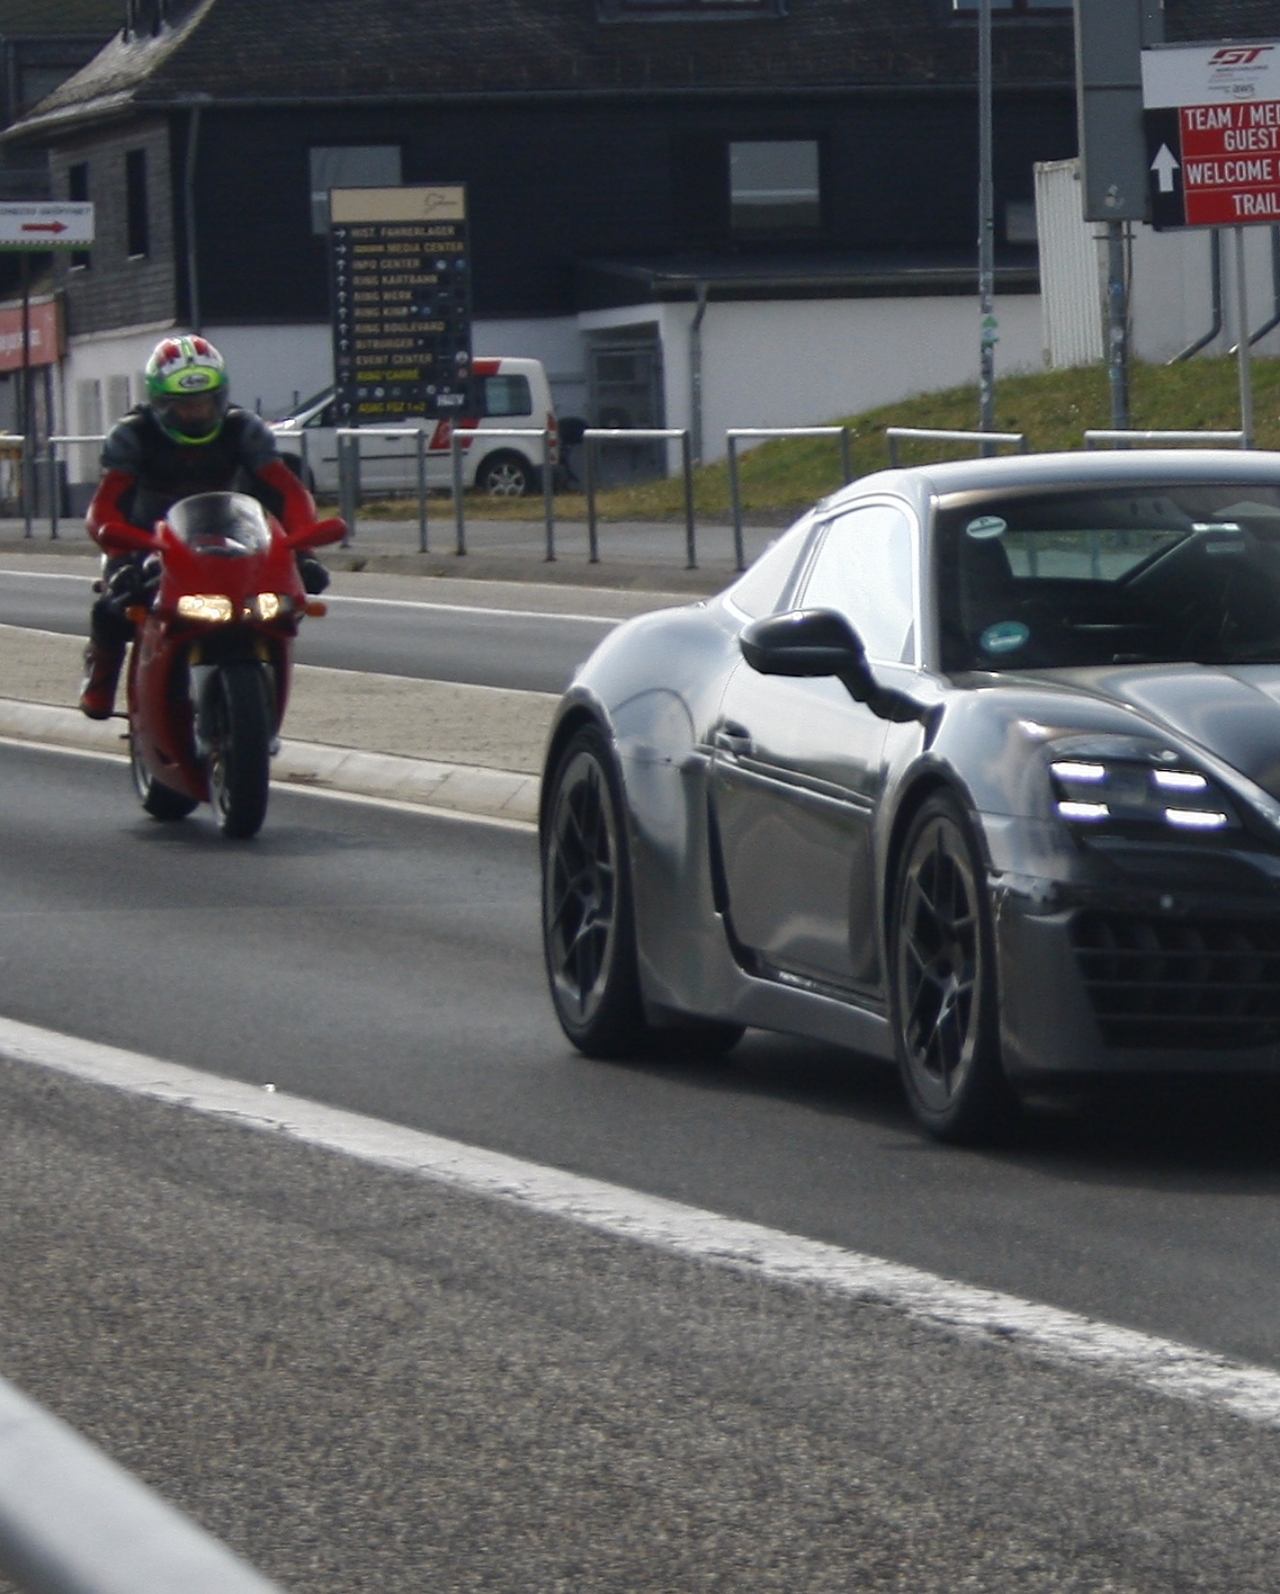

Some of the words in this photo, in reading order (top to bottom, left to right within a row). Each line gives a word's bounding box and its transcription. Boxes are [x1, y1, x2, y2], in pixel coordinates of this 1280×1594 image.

[1186, 107, 1232, 130] TEAM
[1238, 105, 1244, 127] /
[1224, 127, 1280, 151] GUEST
[1187, 159, 1273, 184] WELCOME
[386, 242, 420, 254] MEDIA
[423, 240, 464, 253] CENTER
[379, 258, 420, 269] CENTER
[383, 321, 445, 332] BOULEVARD
[356, 354, 388, 366] EVENT
[391, 352, 433, 364] CENTER
